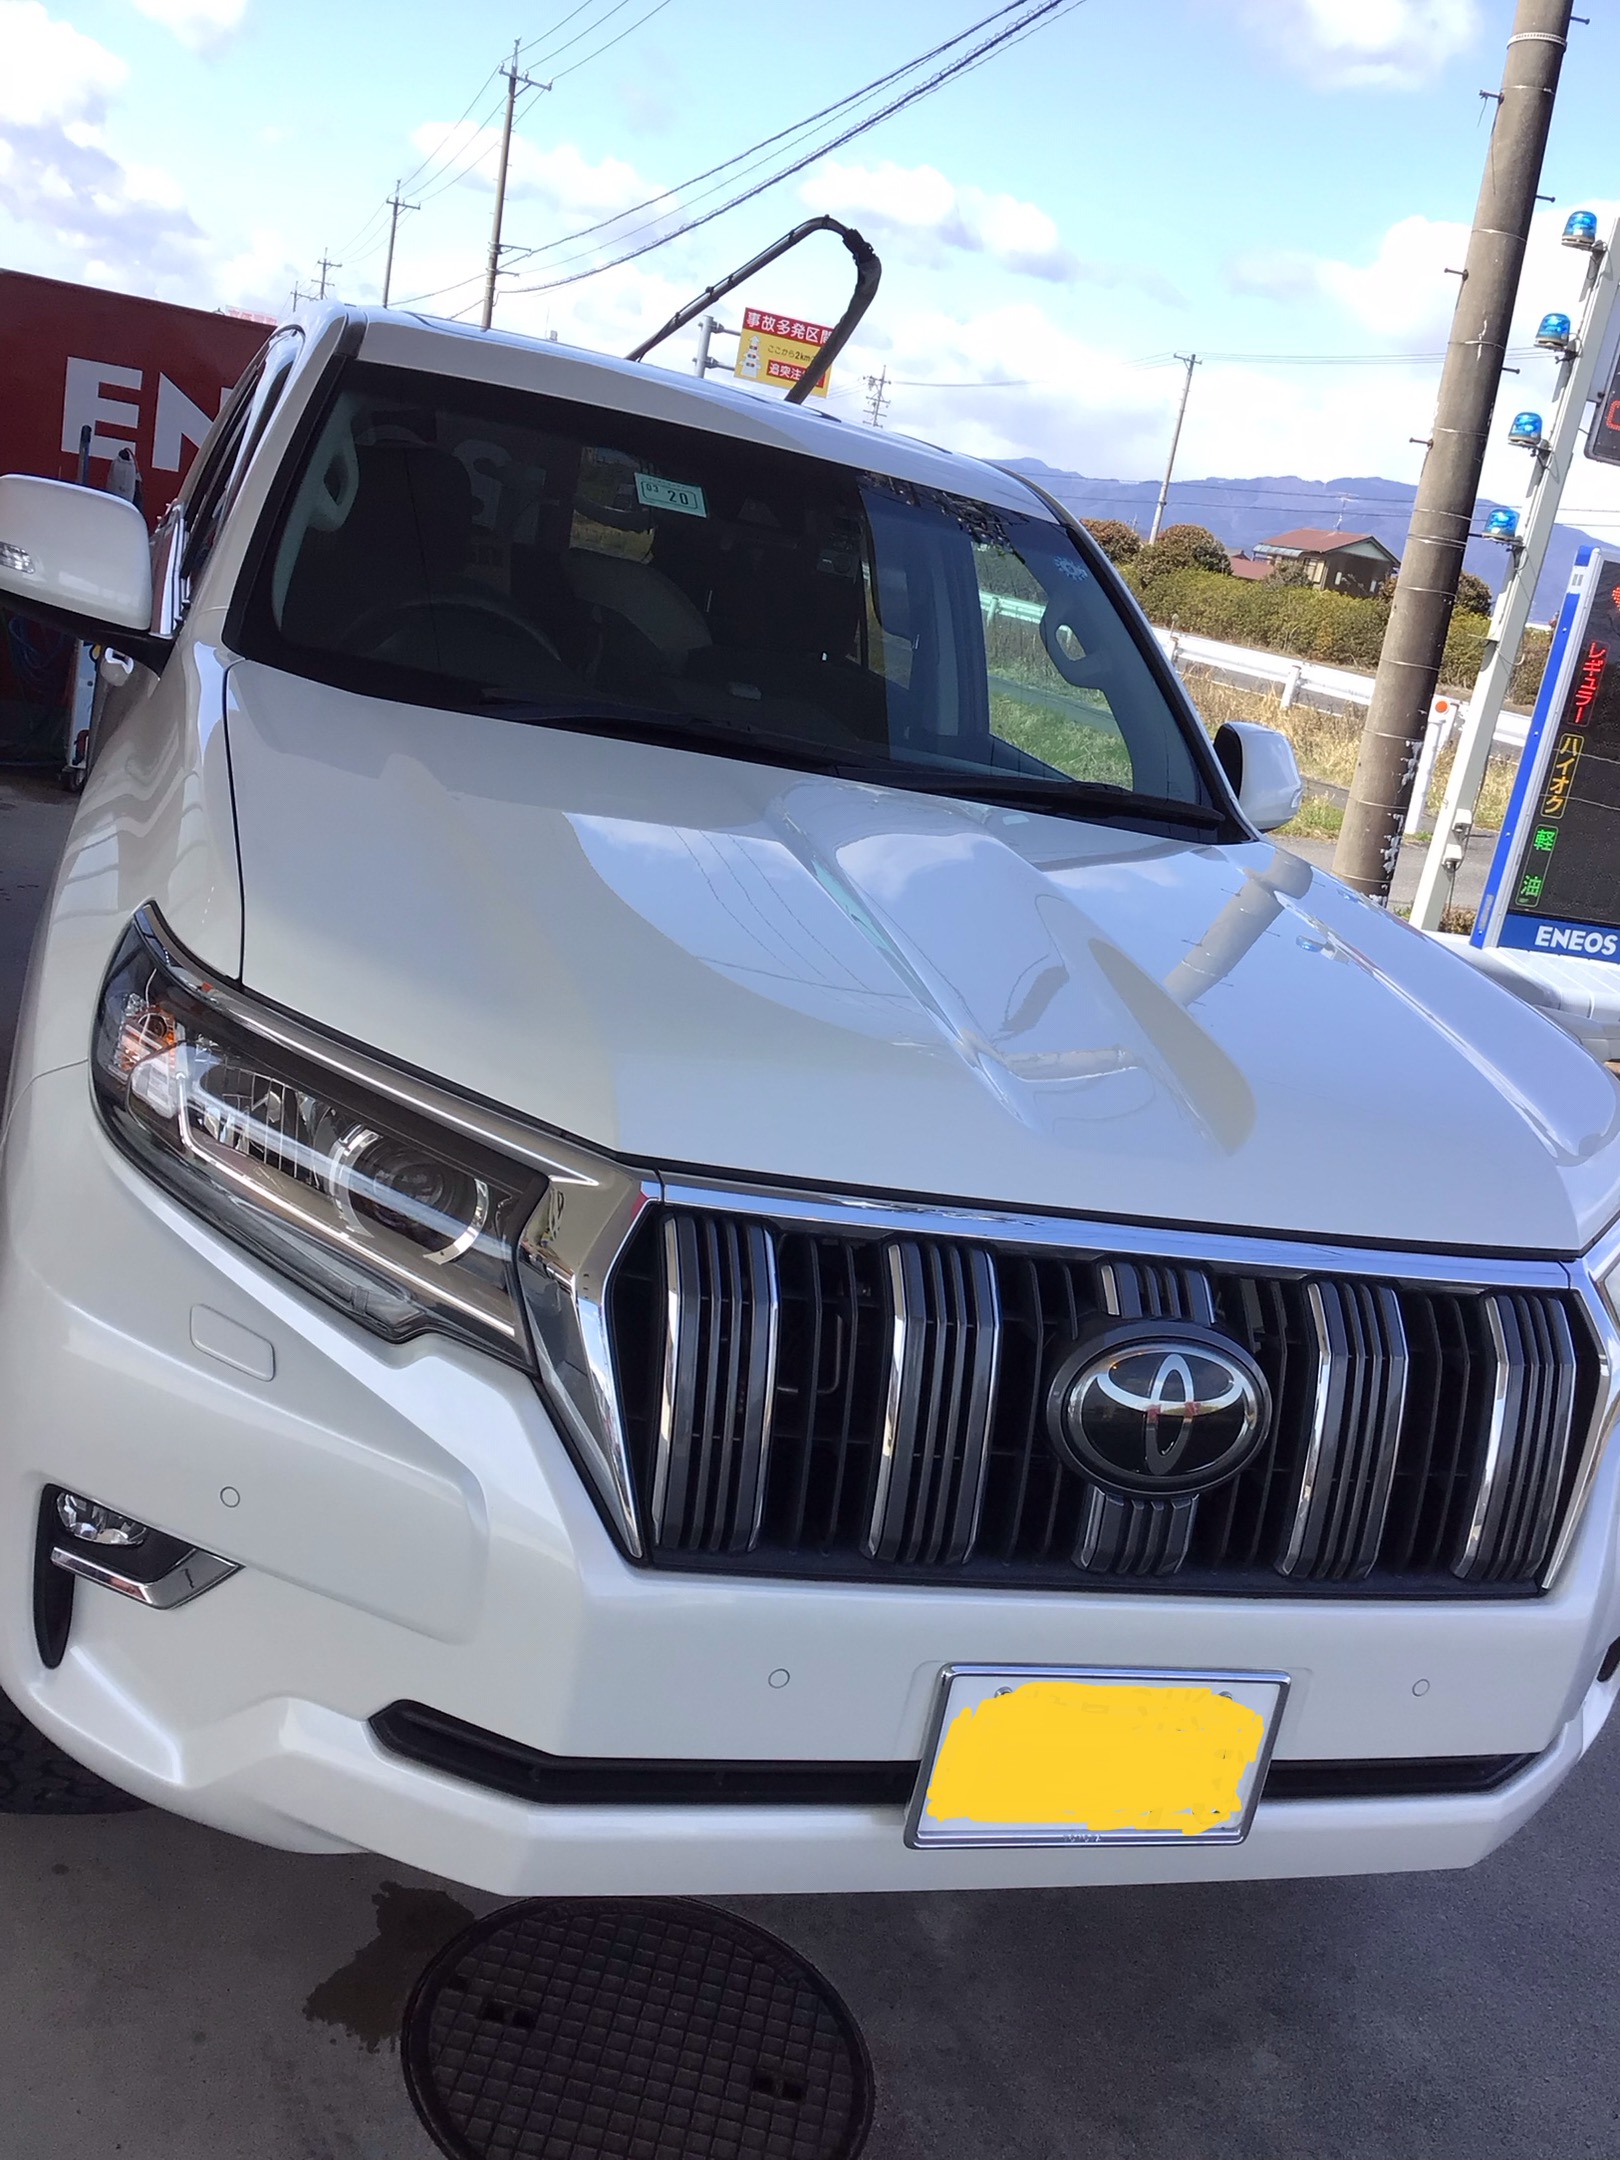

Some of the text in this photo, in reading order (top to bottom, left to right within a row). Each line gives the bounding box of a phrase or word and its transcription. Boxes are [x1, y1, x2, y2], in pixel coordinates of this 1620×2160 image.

[767, 344, 815, 362] ここから2km
[768, 362, 806, 381] 追突注
[667, 489, 689, 505] 20
[1574, 641, 1607, 724] レギュラー
[1544, 737, 1578, 814] ハイオク
[1534, 924, 1619, 956] ENEOS
